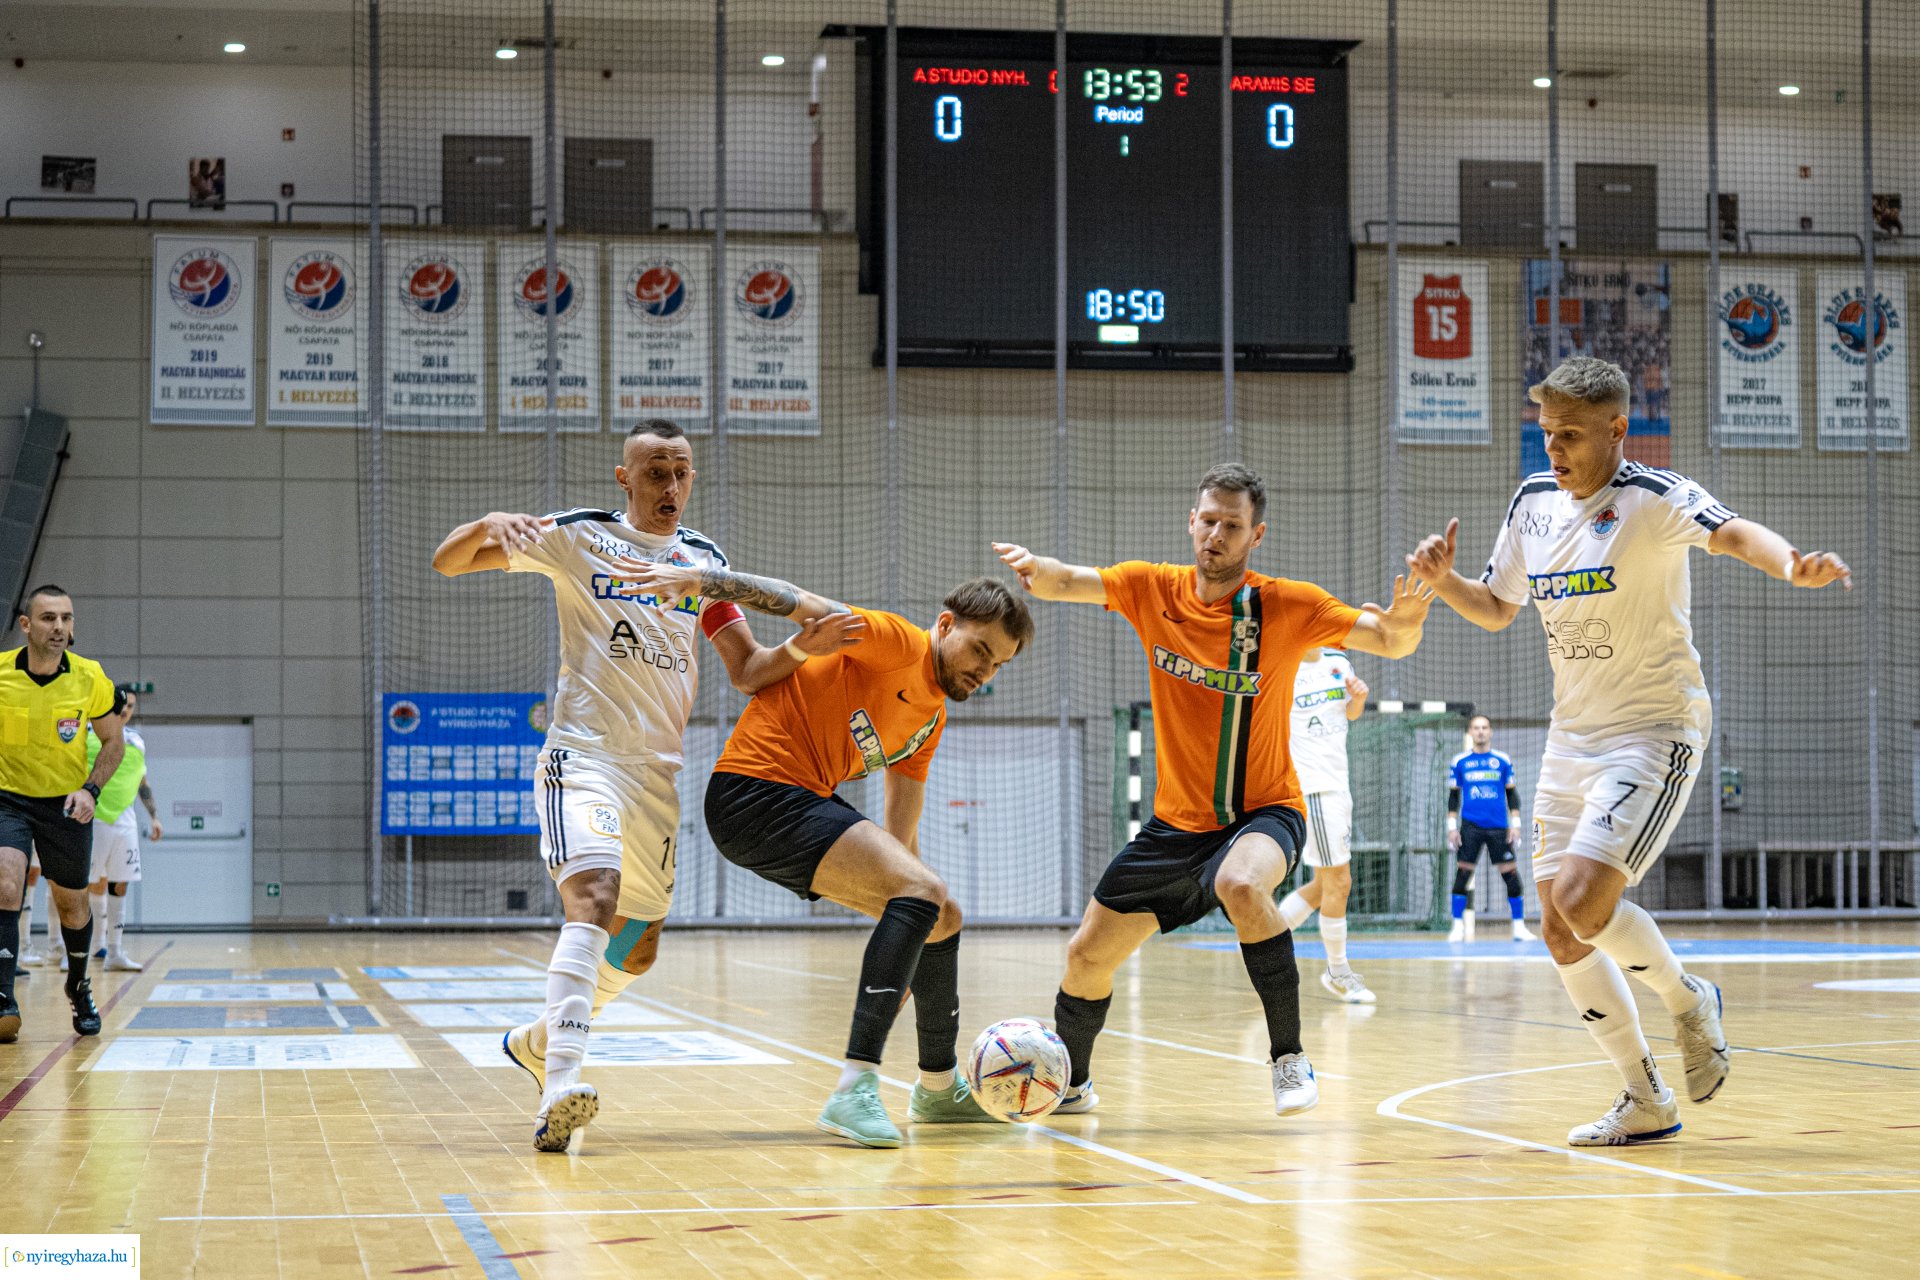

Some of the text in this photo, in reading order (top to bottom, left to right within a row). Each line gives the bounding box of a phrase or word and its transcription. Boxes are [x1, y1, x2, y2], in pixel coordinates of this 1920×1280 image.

[913, 68, 1030, 86] A STUDIO NYH.
[1083, 67, 1163, 101] 13:53
[1174, 73, 1190, 97] 2
[1231, 75, 1317, 93] ARAMIS SE
[934, 95, 963, 142] 0
[1096, 105, 1144, 124] Period
[1267, 103, 1295, 149] 0
[1119, 134, 1130, 157] 1
[1086, 289, 1166, 323] 18:50
[1426, 304, 1459, 342] 15
[190, 349, 218, 363] 2019
[306, 352, 334, 366] 2019
[421, 355, 449, 369] 2018
[648, 358, 674, 371] 2017
[161, 366, 196, 378] MAGYAR
[280, 370, 358, 382] MAGYAR KUPA
[757, 361, 784, 375] 2017
[511, 375, 549, 387] MAGYA
[1742, 378, 1766, 390] 2017
[178, 383, 246, 400] HELYEZÉS
[1520, 511, 1551, 537] 383
[590, 534, 631, 558] 383
[609, 644, 689, 674] STUDIO
[1617, 781, 1639, 811] 7
[558, 1018, 590, 1034] JAKO
